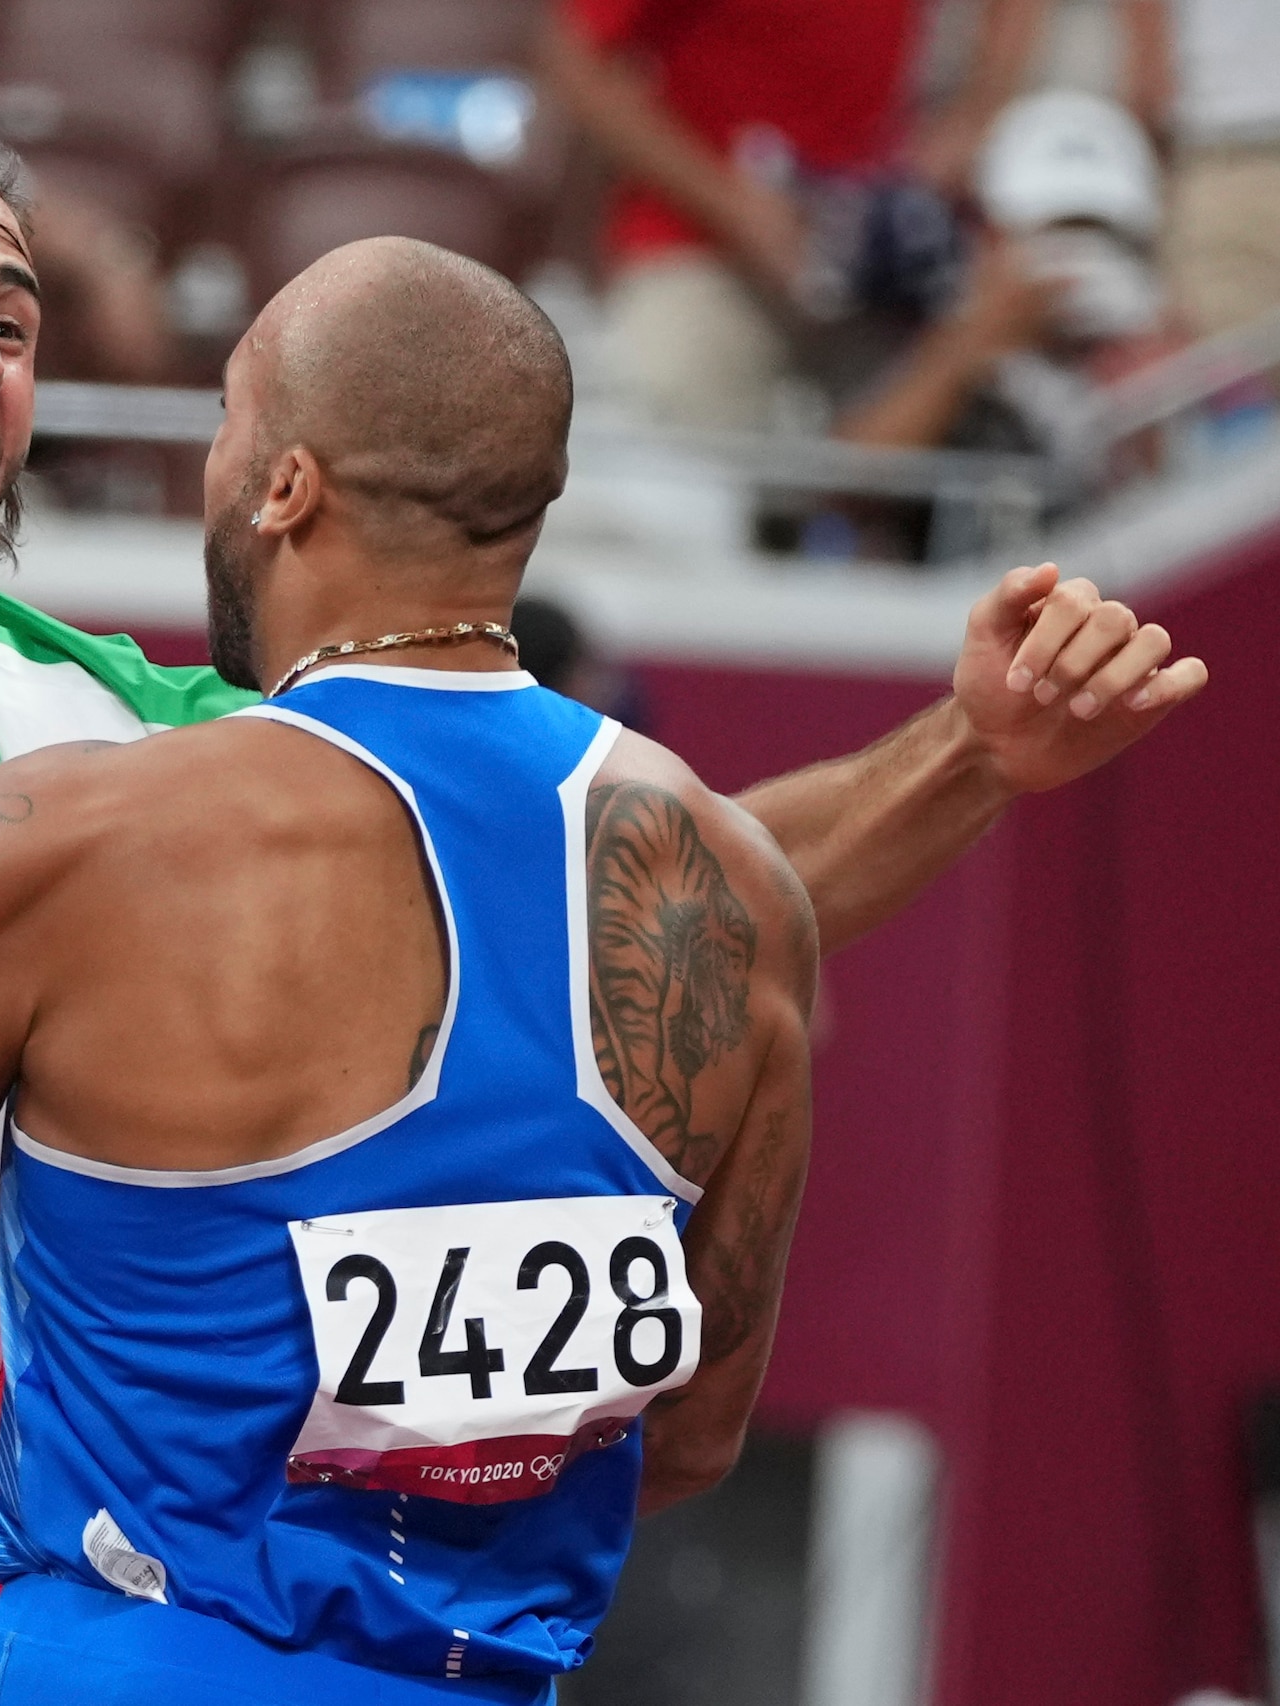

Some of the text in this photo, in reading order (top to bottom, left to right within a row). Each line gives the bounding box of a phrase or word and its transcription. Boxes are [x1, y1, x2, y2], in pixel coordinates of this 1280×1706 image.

[326, 1236, 682, 1405] 2428
[420, 1462, 524, 1484] TOKYO 2020
